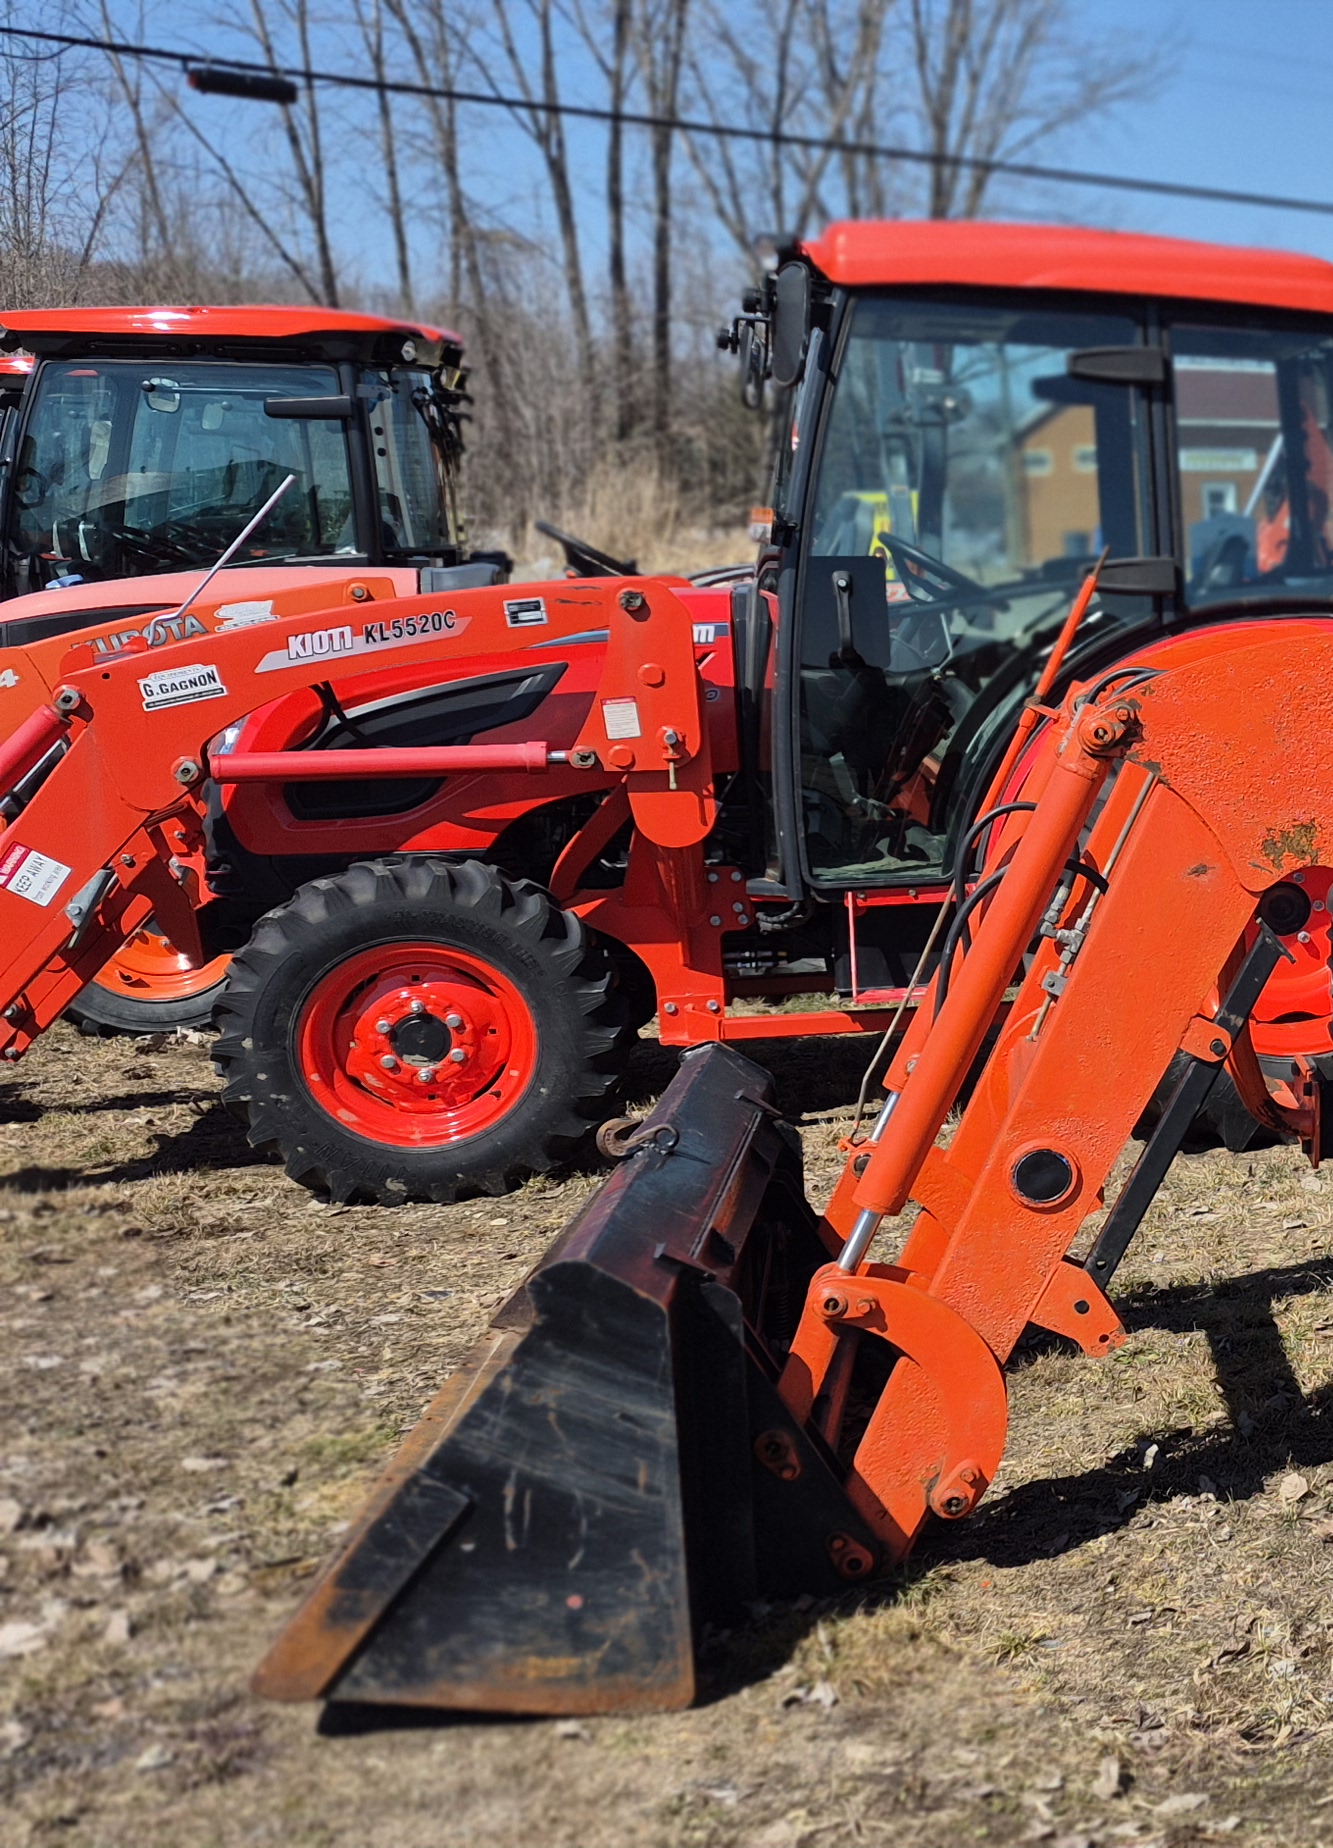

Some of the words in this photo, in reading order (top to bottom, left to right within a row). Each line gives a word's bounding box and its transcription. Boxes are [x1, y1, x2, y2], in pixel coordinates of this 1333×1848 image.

[288, 625, 353, 661] KIOTI
[364, 610, 457, 644] KL5520C
[143, 669, 218, 698] G.GAGNON
[26, 855, 47, 878] AWAY
